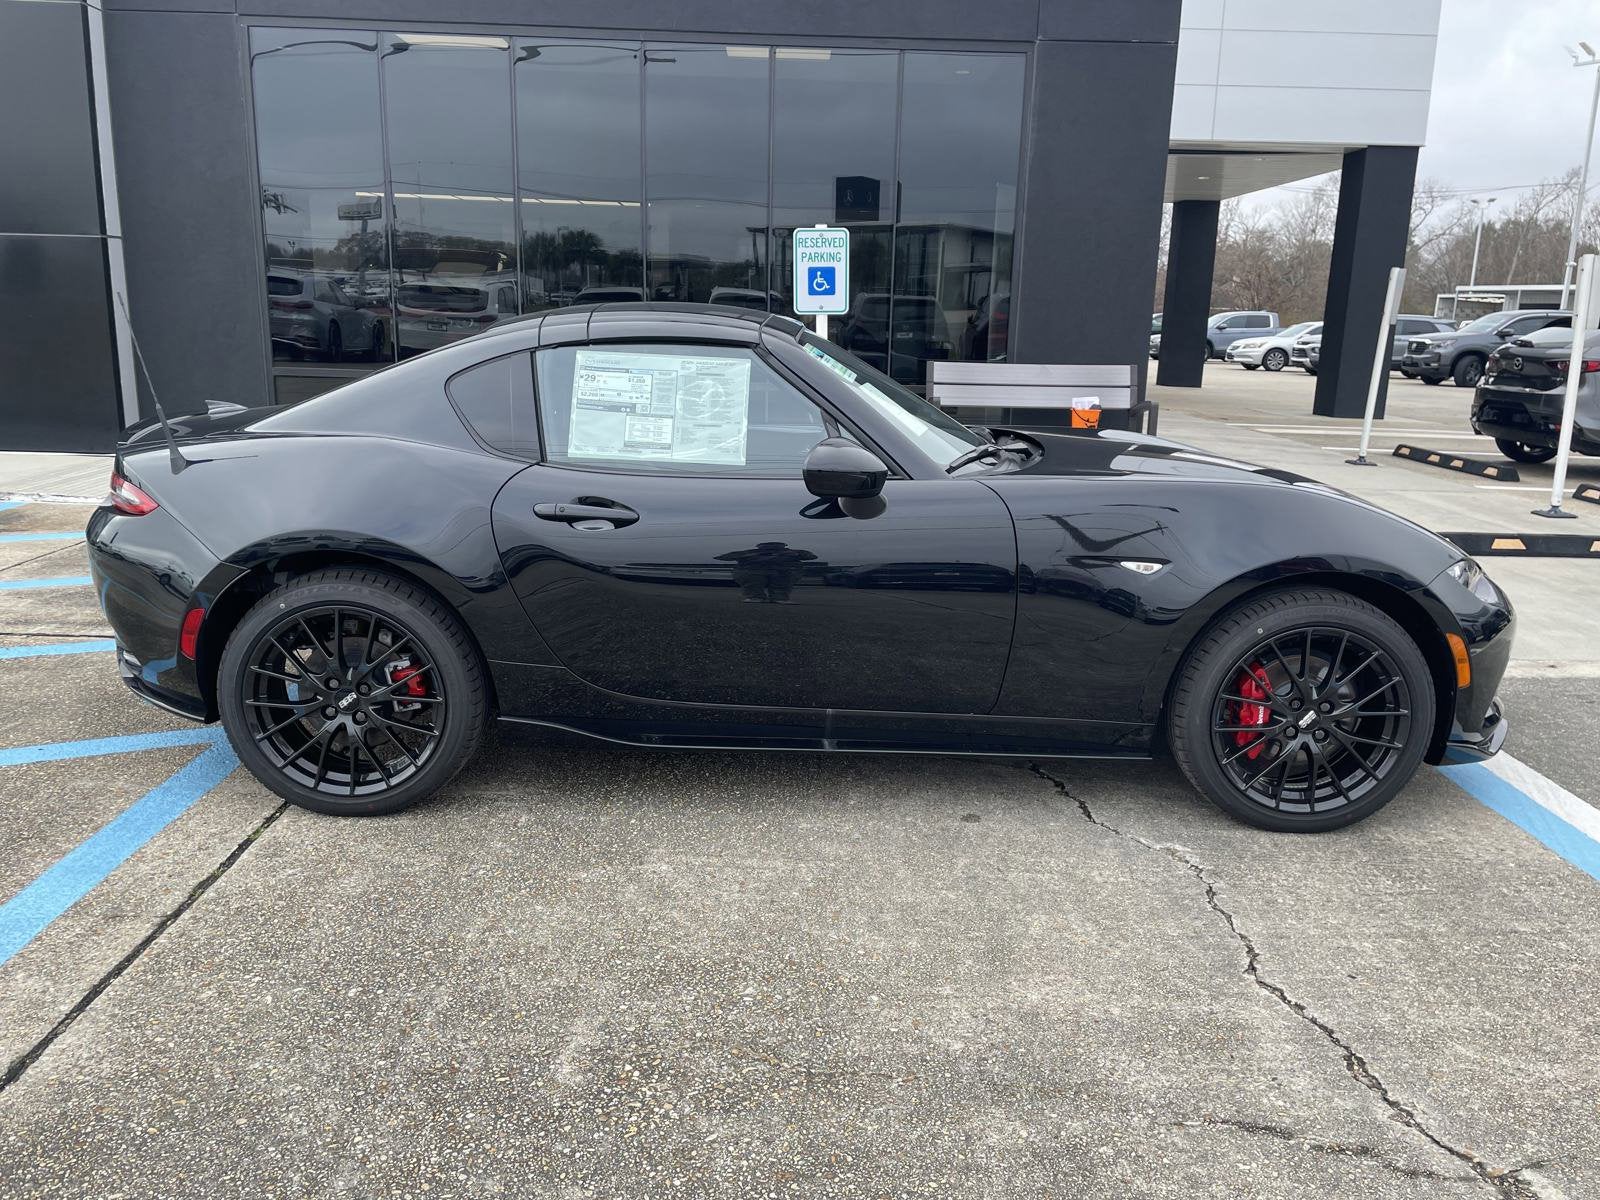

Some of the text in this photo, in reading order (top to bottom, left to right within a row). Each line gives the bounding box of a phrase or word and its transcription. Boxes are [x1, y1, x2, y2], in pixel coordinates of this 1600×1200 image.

[798, 237, 845, 248] RESERVED
[801, 252, 842, 263] PARKING
[584, 373, 596, 382] 29
